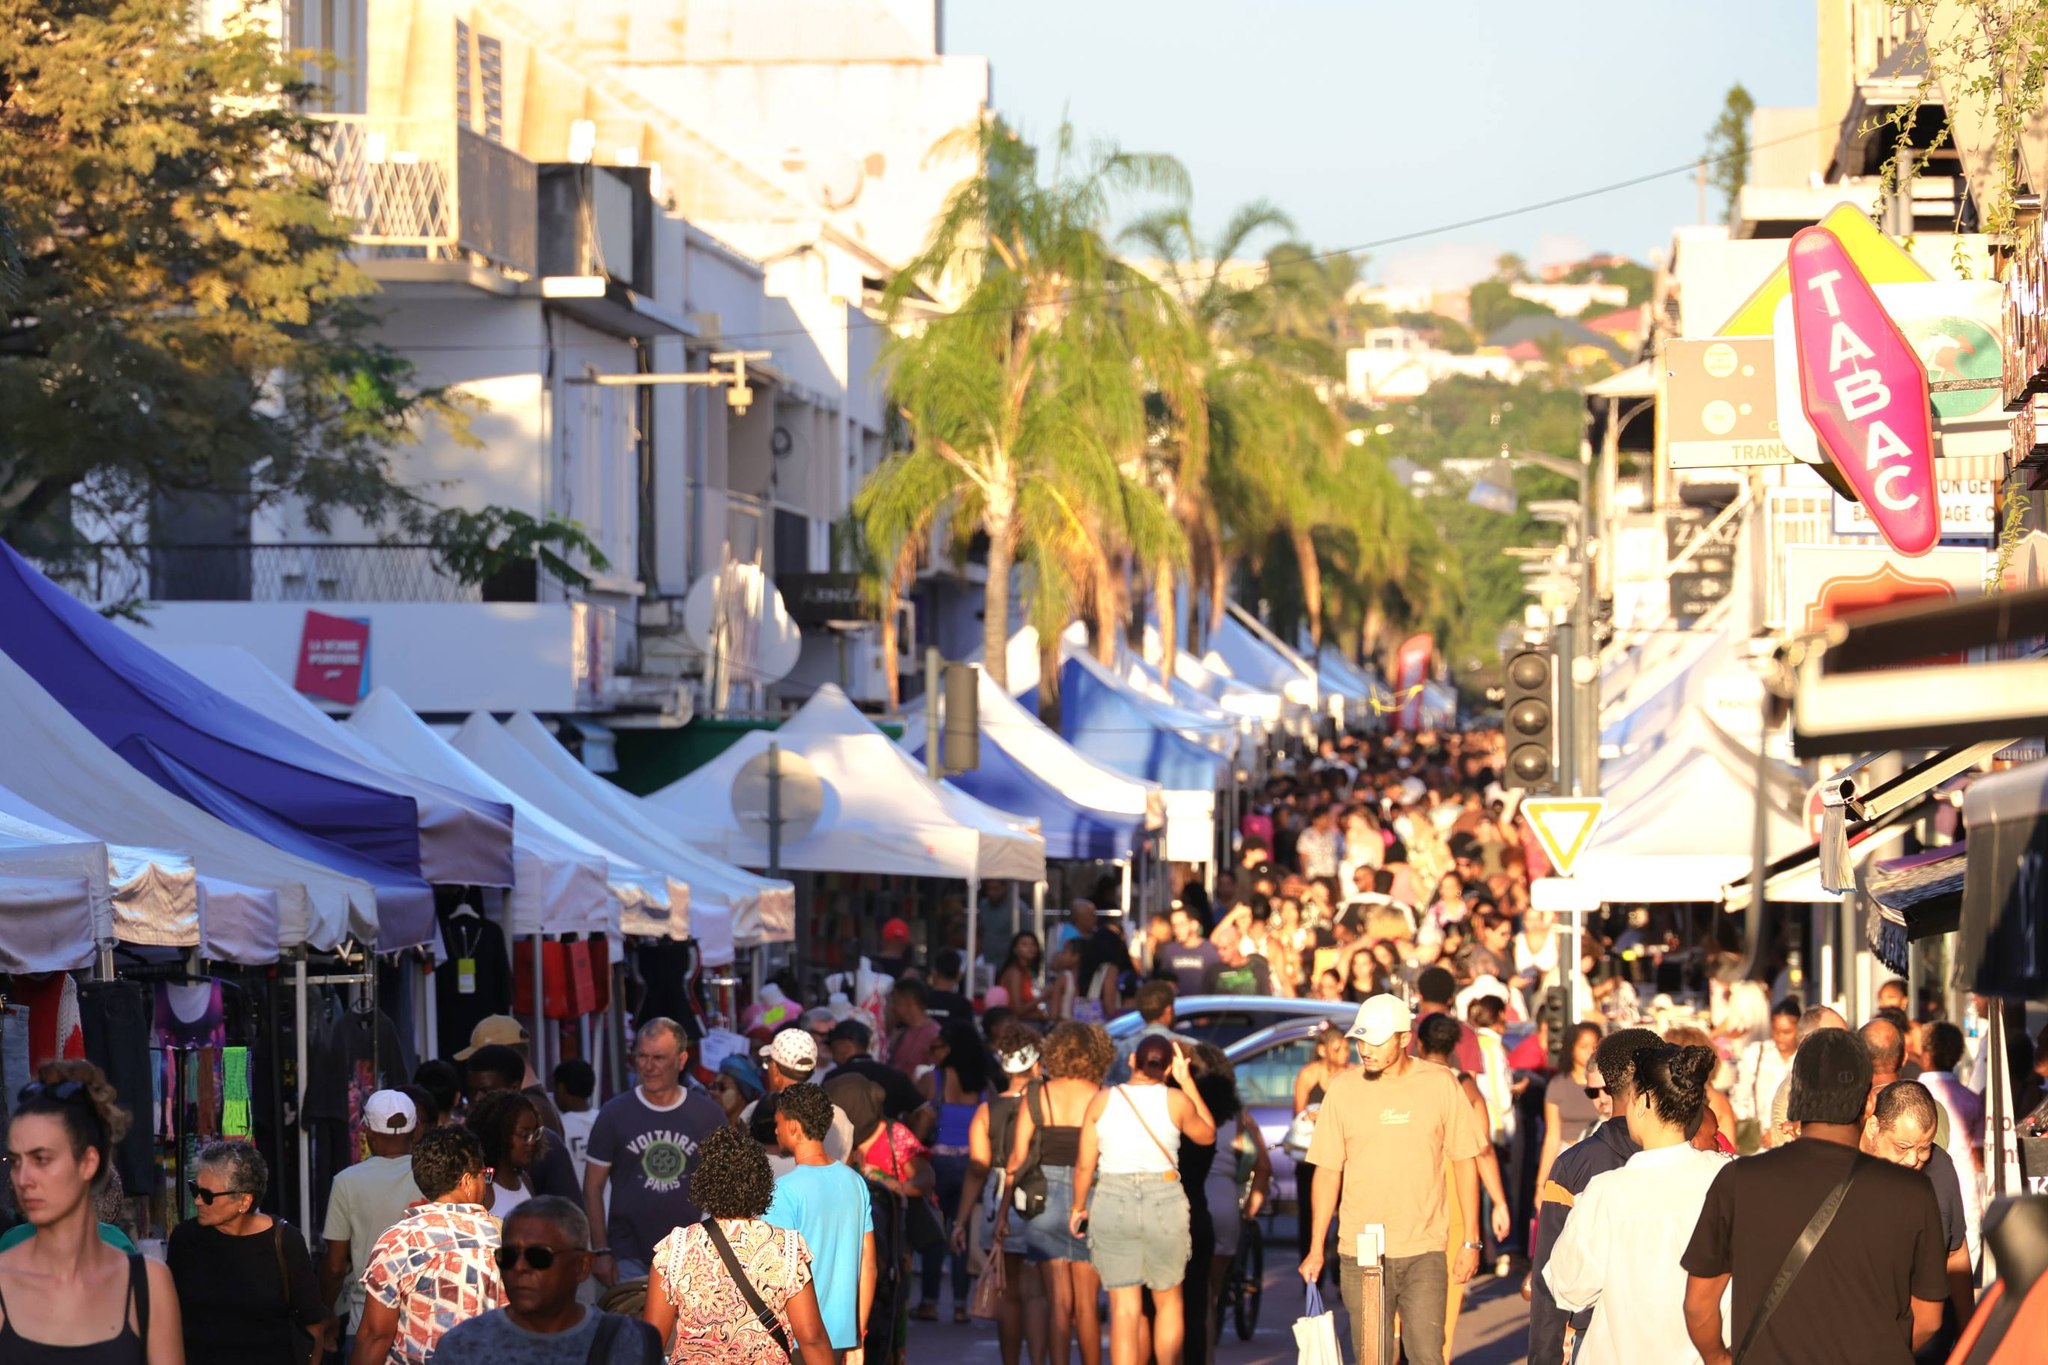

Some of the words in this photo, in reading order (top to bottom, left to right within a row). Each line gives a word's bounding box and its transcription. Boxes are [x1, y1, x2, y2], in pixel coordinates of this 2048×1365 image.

[1807, 269, 1920, 511] TABAC
[626, 1130, 698, 1156] VOLTAIRE
[644, 1177, 681, 1192] PARIS
